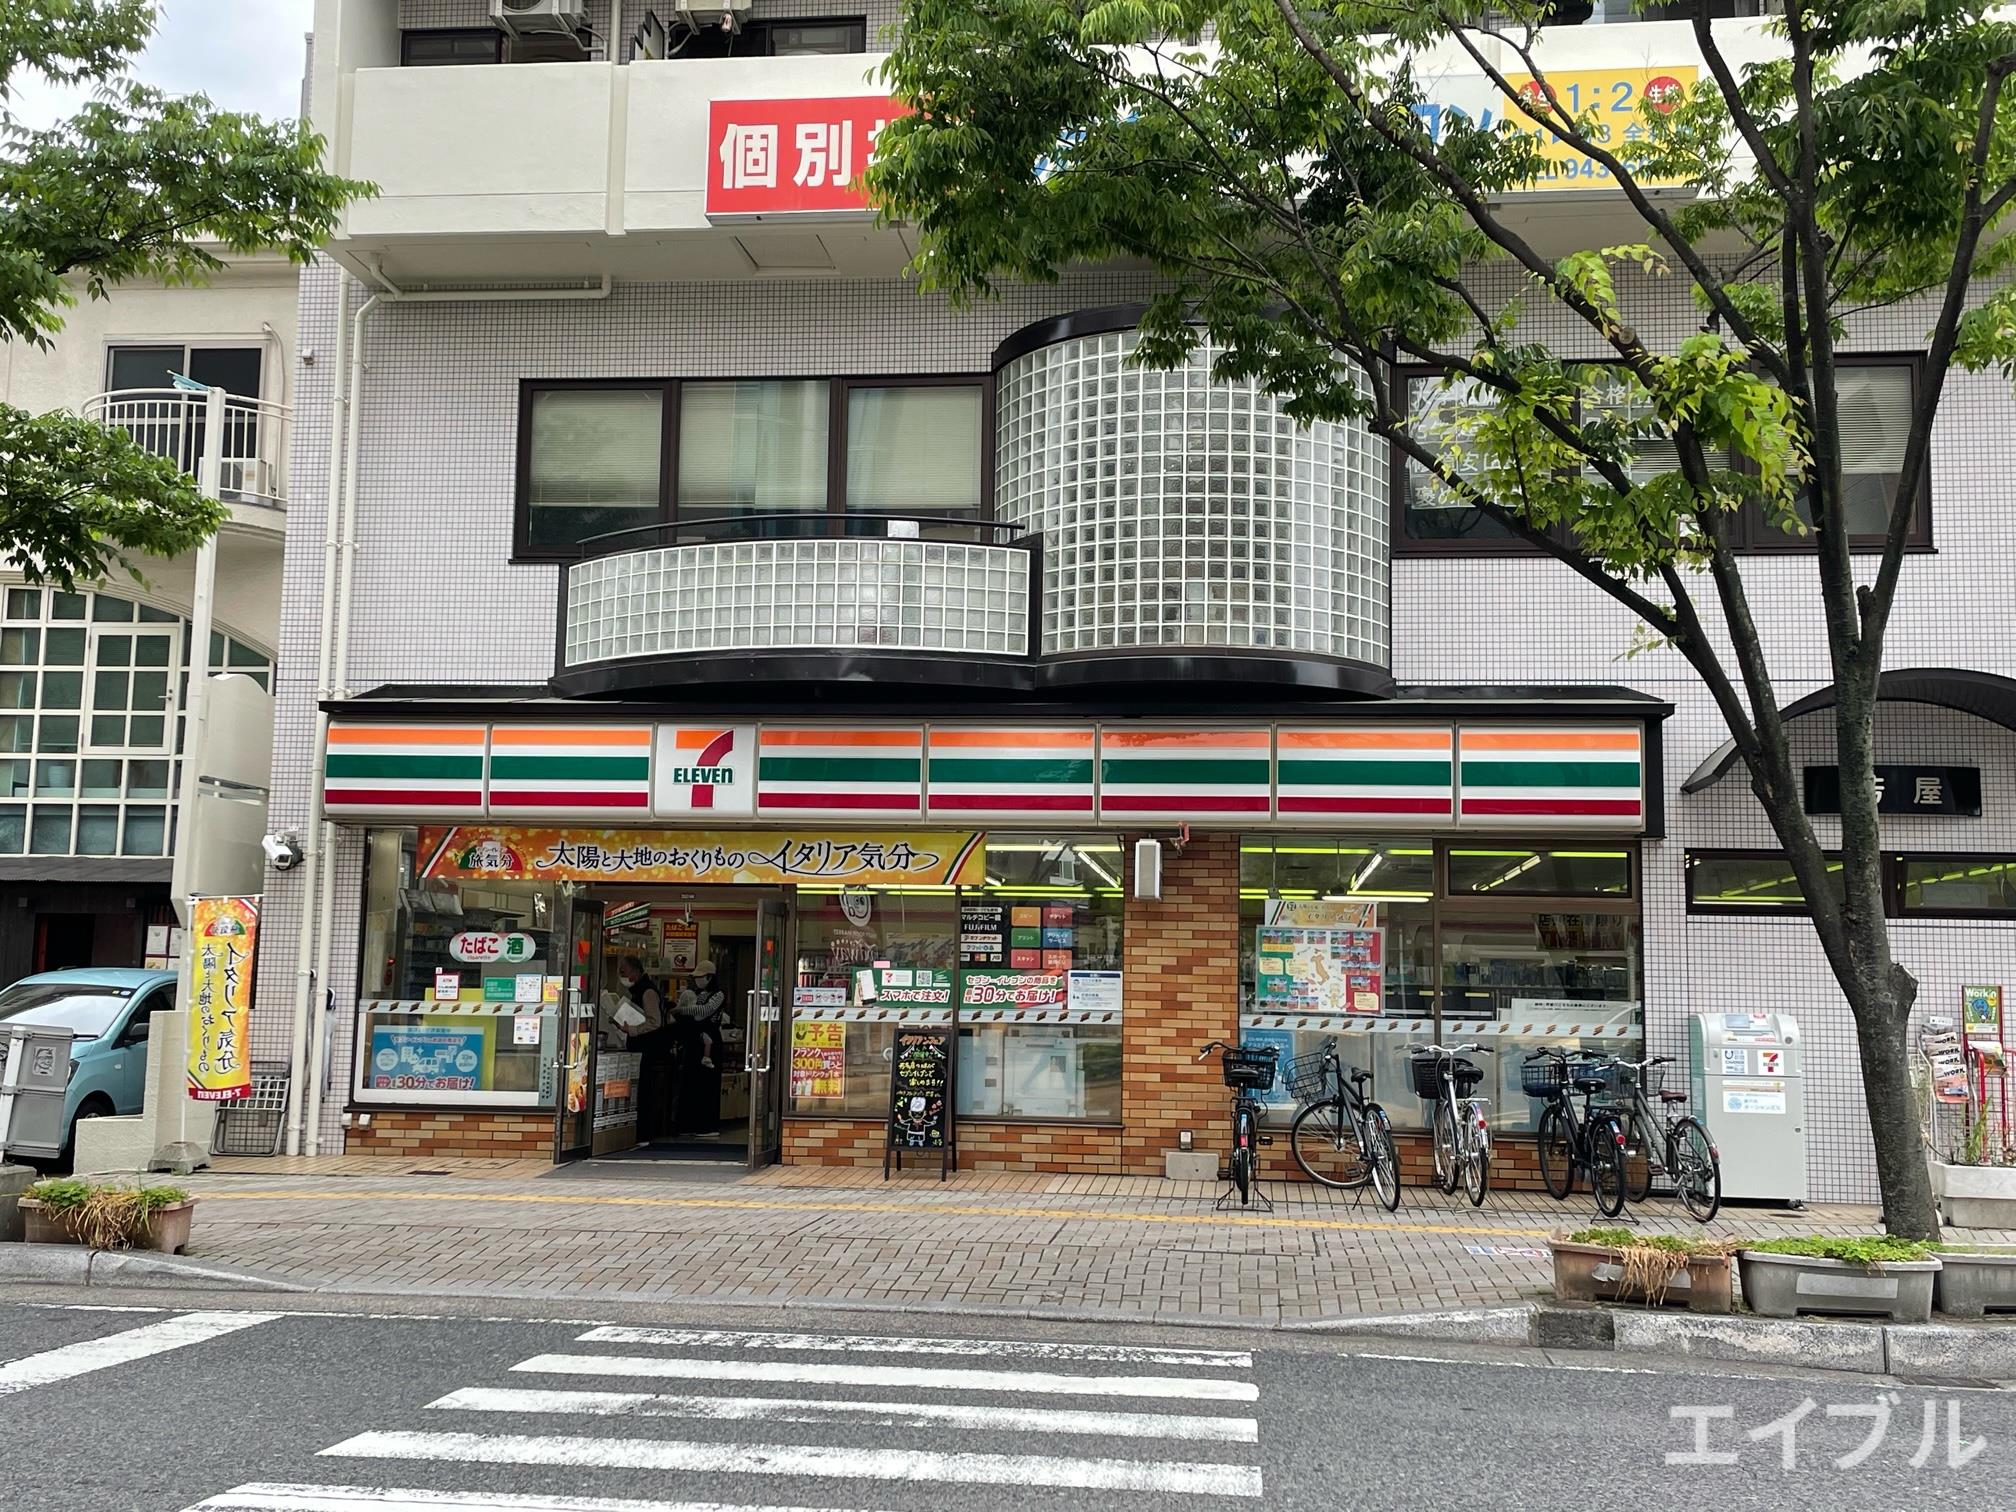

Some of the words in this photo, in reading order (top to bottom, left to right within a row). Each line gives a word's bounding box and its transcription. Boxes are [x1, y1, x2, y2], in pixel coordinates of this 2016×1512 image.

[719, 119, 894, 189] 個別
[460, 937, 499, 954] たばこ
[507, 937, 525, 955] 酒
[808, 1023, 844, 1042] 予告
